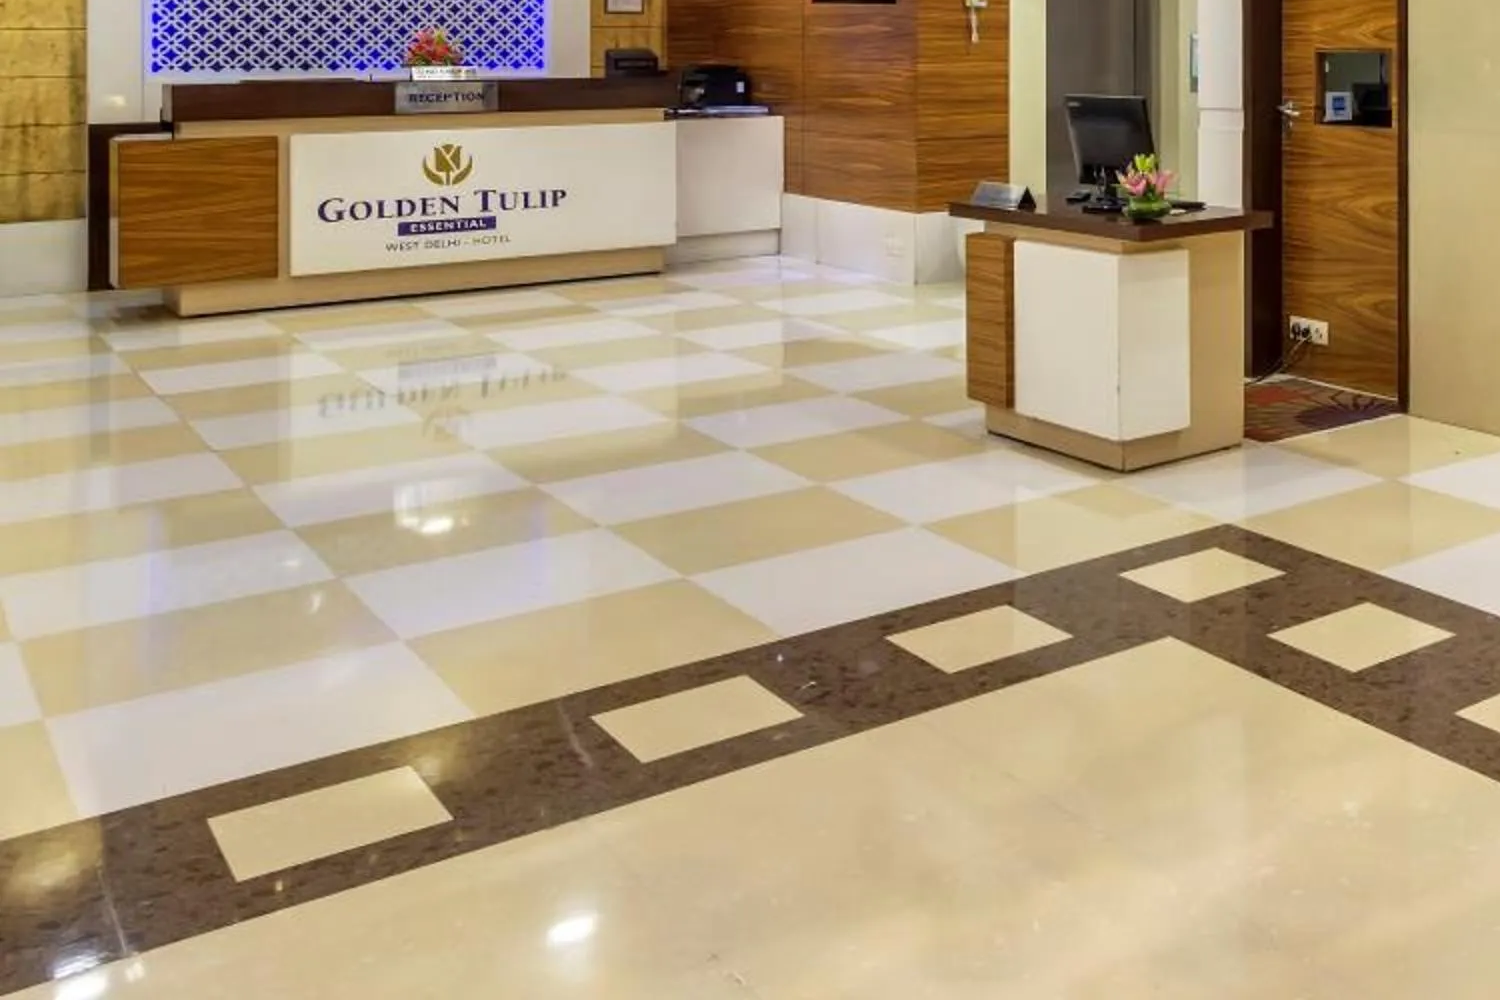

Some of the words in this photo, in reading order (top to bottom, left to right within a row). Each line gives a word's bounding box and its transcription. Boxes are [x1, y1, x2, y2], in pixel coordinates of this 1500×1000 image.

[408, 92, 485, 103] RECEPTION
[317, 195, 460, 223] GOLDEN
[473, 188, 568, 213] TULIP
[410, 219, 488, 234] ESSENTIAL
[385, 241, 420, 252] WEST
[423, 238, 461, 250] DELHI
[472, 235, 512, 247] HOTEL
